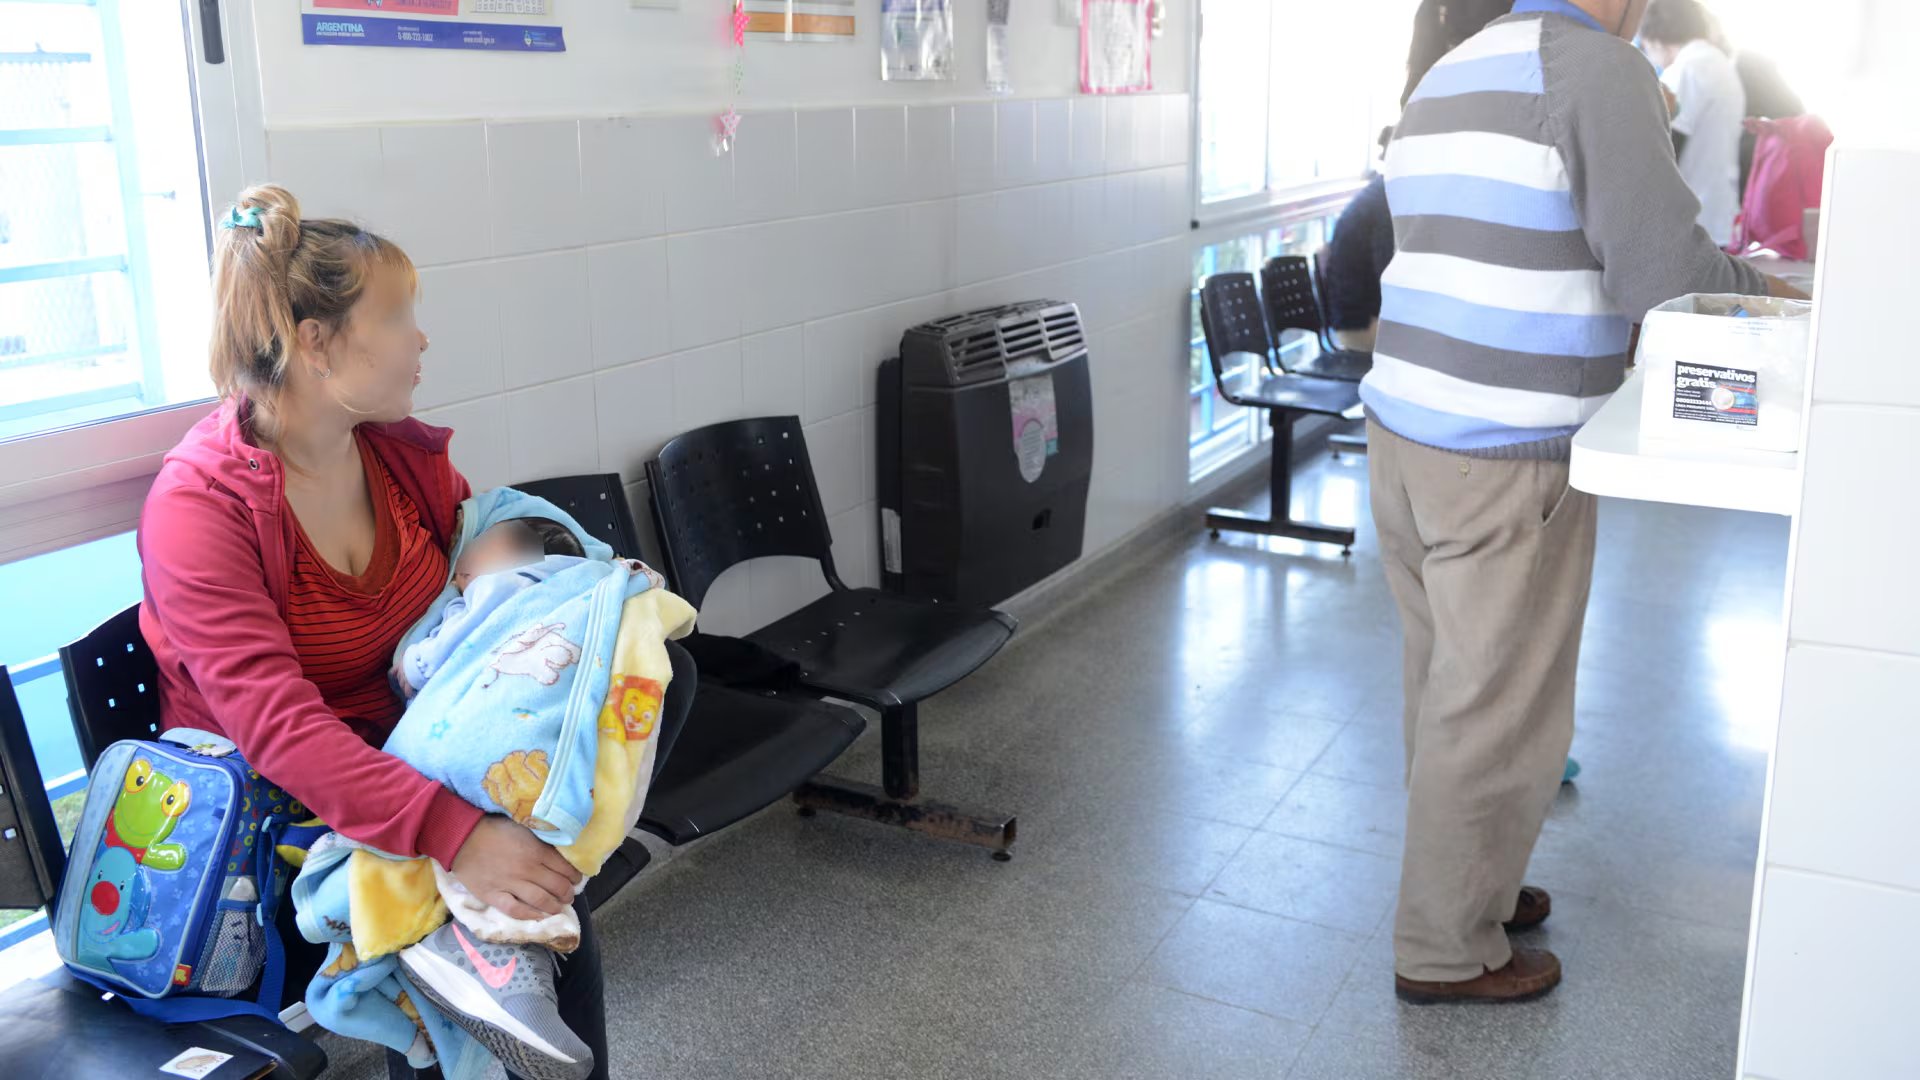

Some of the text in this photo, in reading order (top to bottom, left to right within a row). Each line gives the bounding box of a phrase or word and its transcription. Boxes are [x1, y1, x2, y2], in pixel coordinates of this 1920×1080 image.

[316, 21, 365, 33] ARGENTINA
[1677, 365, 1756, 384] preservativos
[1676, 376, 1716, 388] gratis
